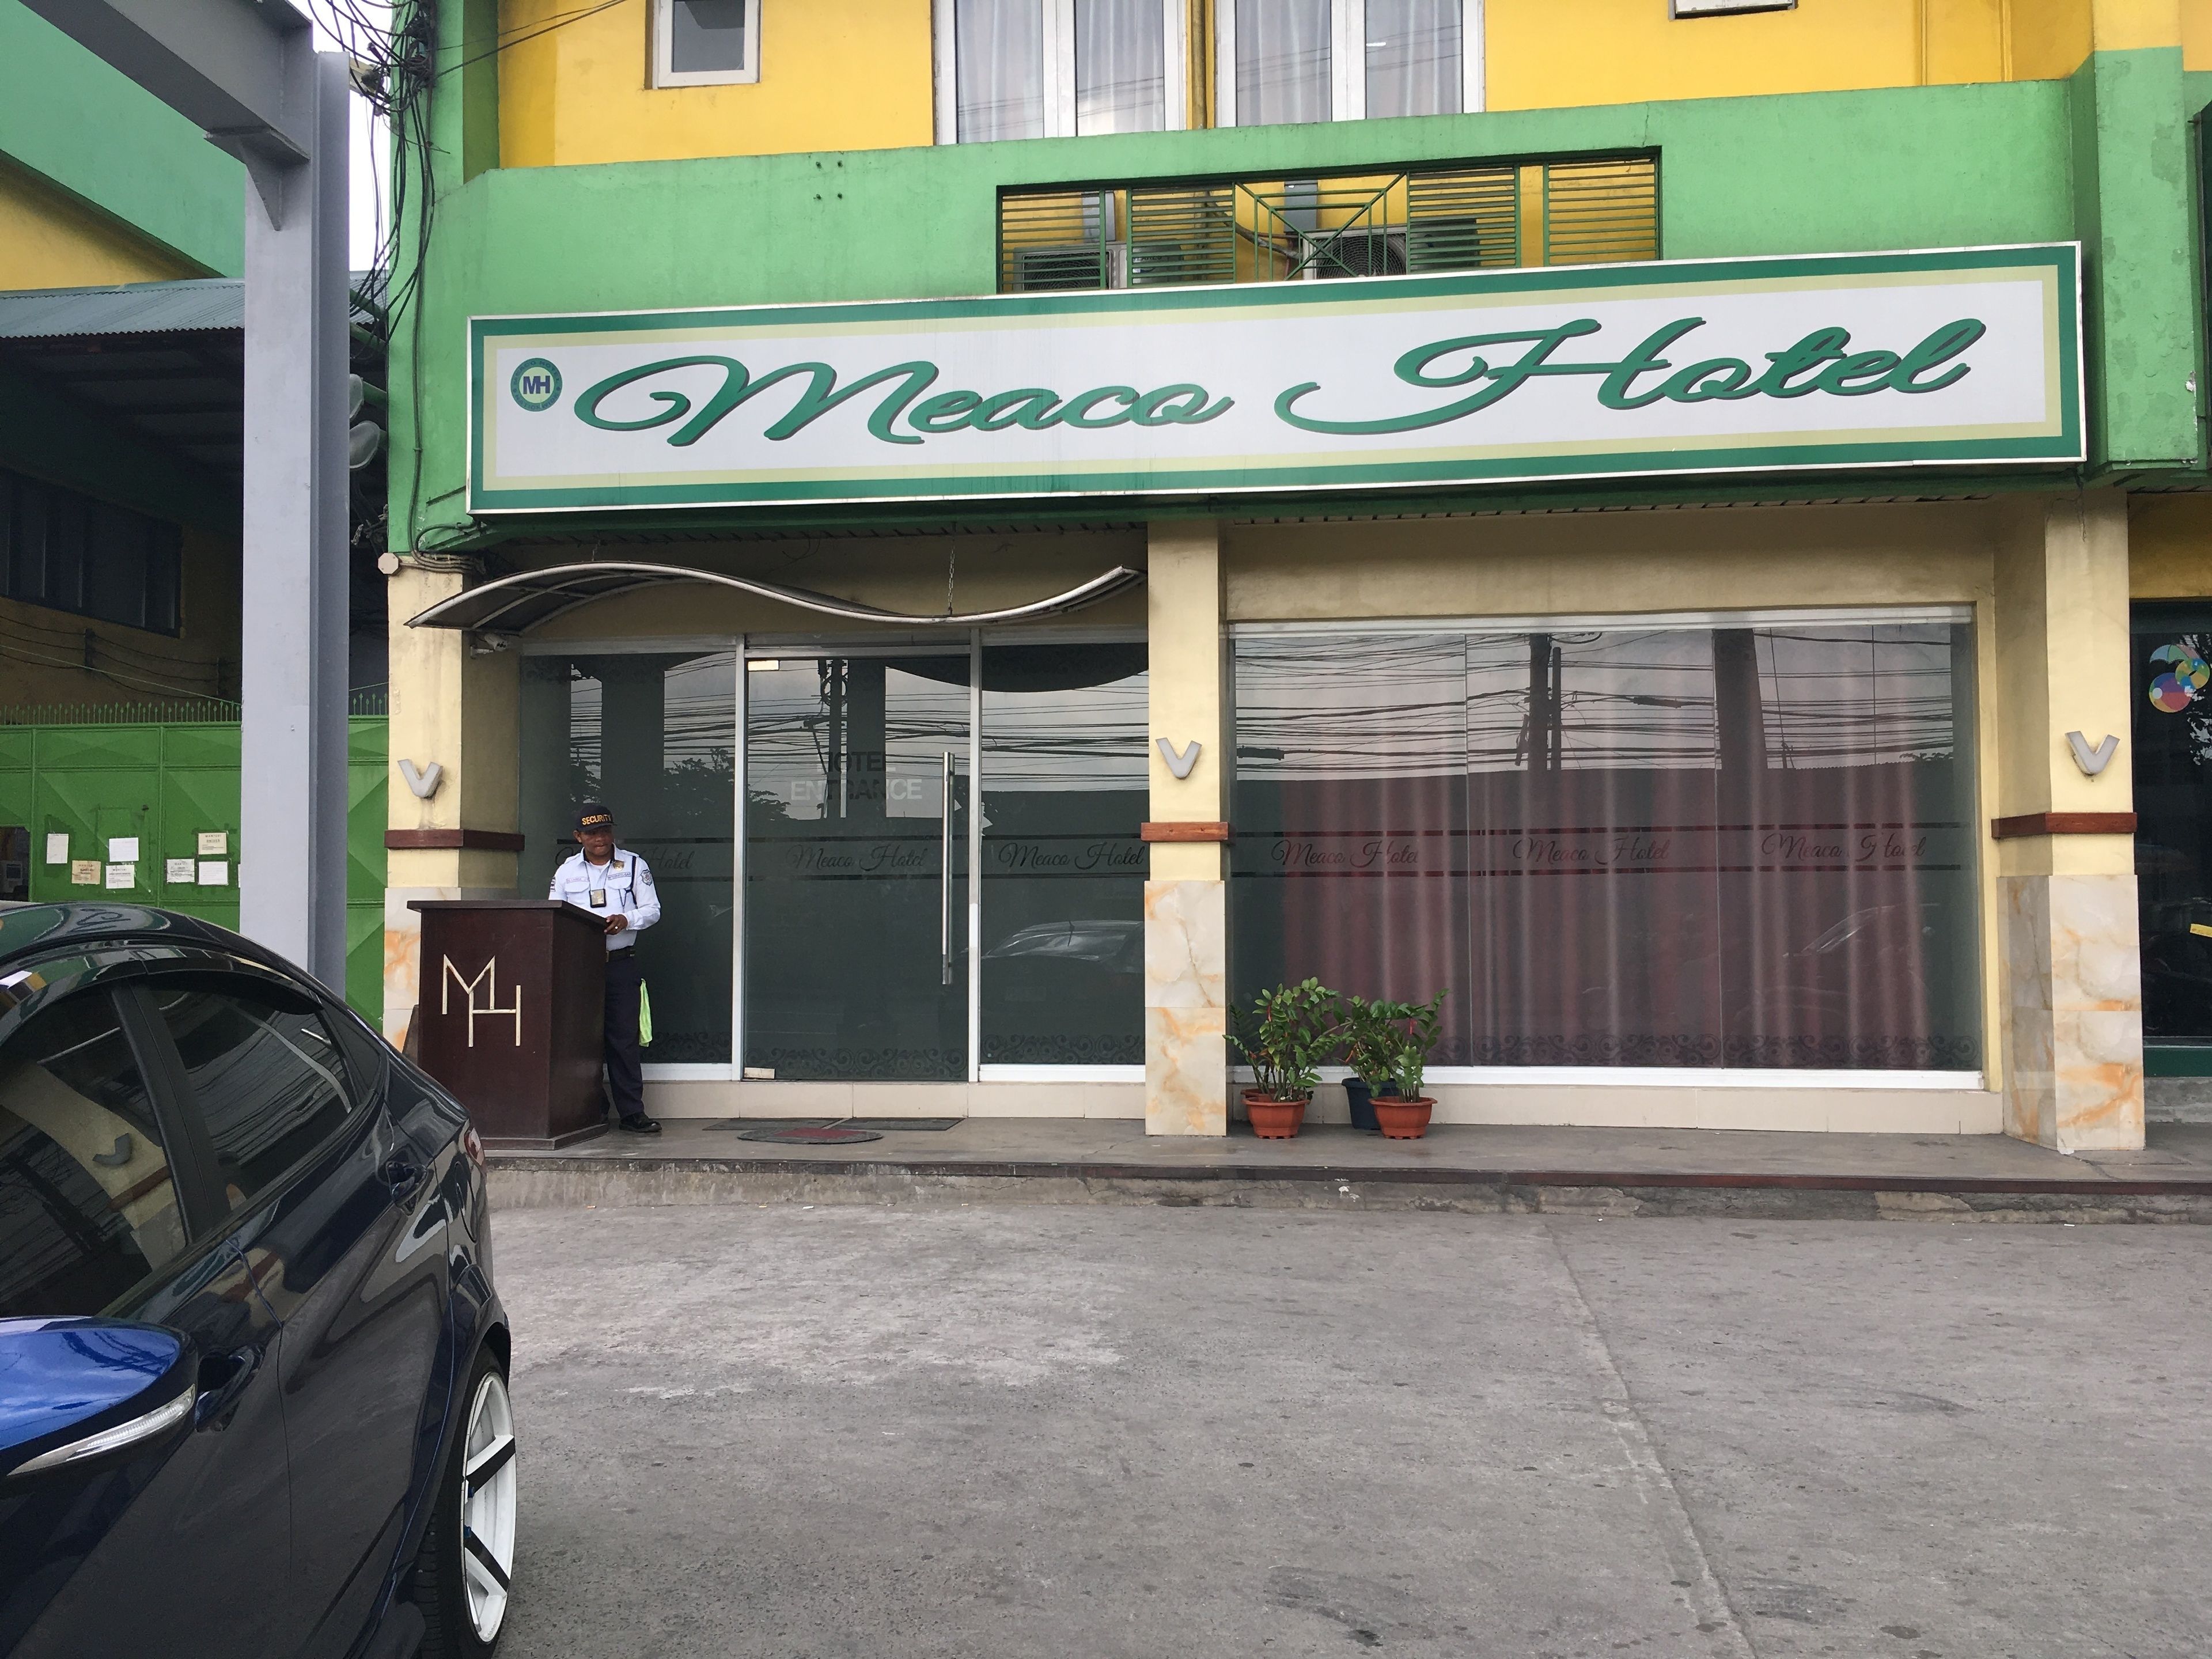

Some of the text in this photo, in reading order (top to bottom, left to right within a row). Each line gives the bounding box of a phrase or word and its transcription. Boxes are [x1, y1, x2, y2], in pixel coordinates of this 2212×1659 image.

[522, 375, 551, 395] MH
[574, 316, 1987, 447] Meaco Hotel
[817, 751, 896, 772] HOTEL
[791, 778, 923, 801] ENTRANCE
[581, 813, 612, 825] SECURITY
[786, 843, 928, 872] Meaco Hotel
[998, 842, 1146, 870] Meaco Hotel
[1271, 839, 1346, 867] Meaco
[1512, 836, 1671, 865] Meaco Hotel
[1761, 834, 1843, 861] Meaco
